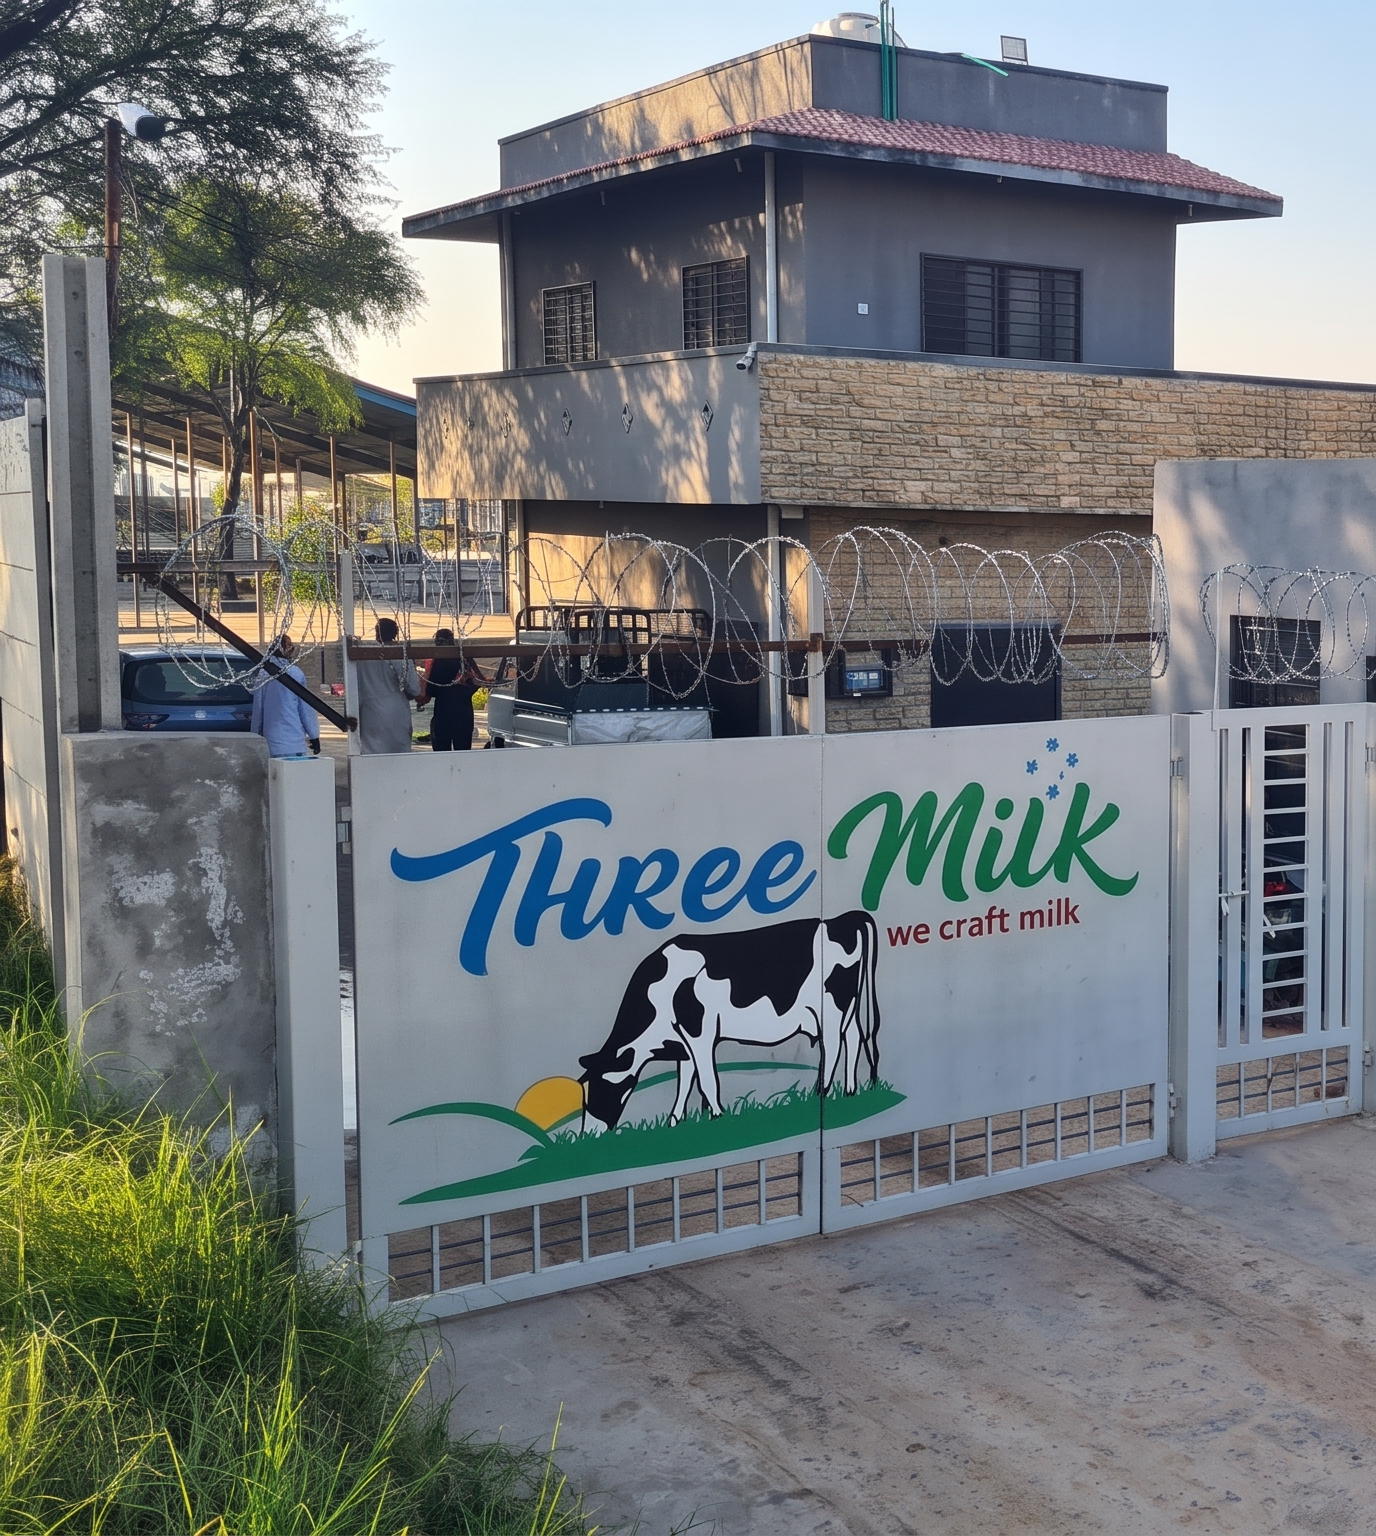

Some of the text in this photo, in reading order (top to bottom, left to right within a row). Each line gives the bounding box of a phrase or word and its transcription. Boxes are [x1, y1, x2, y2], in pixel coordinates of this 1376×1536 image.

[886, 896, 1081, 947] we craft milk
